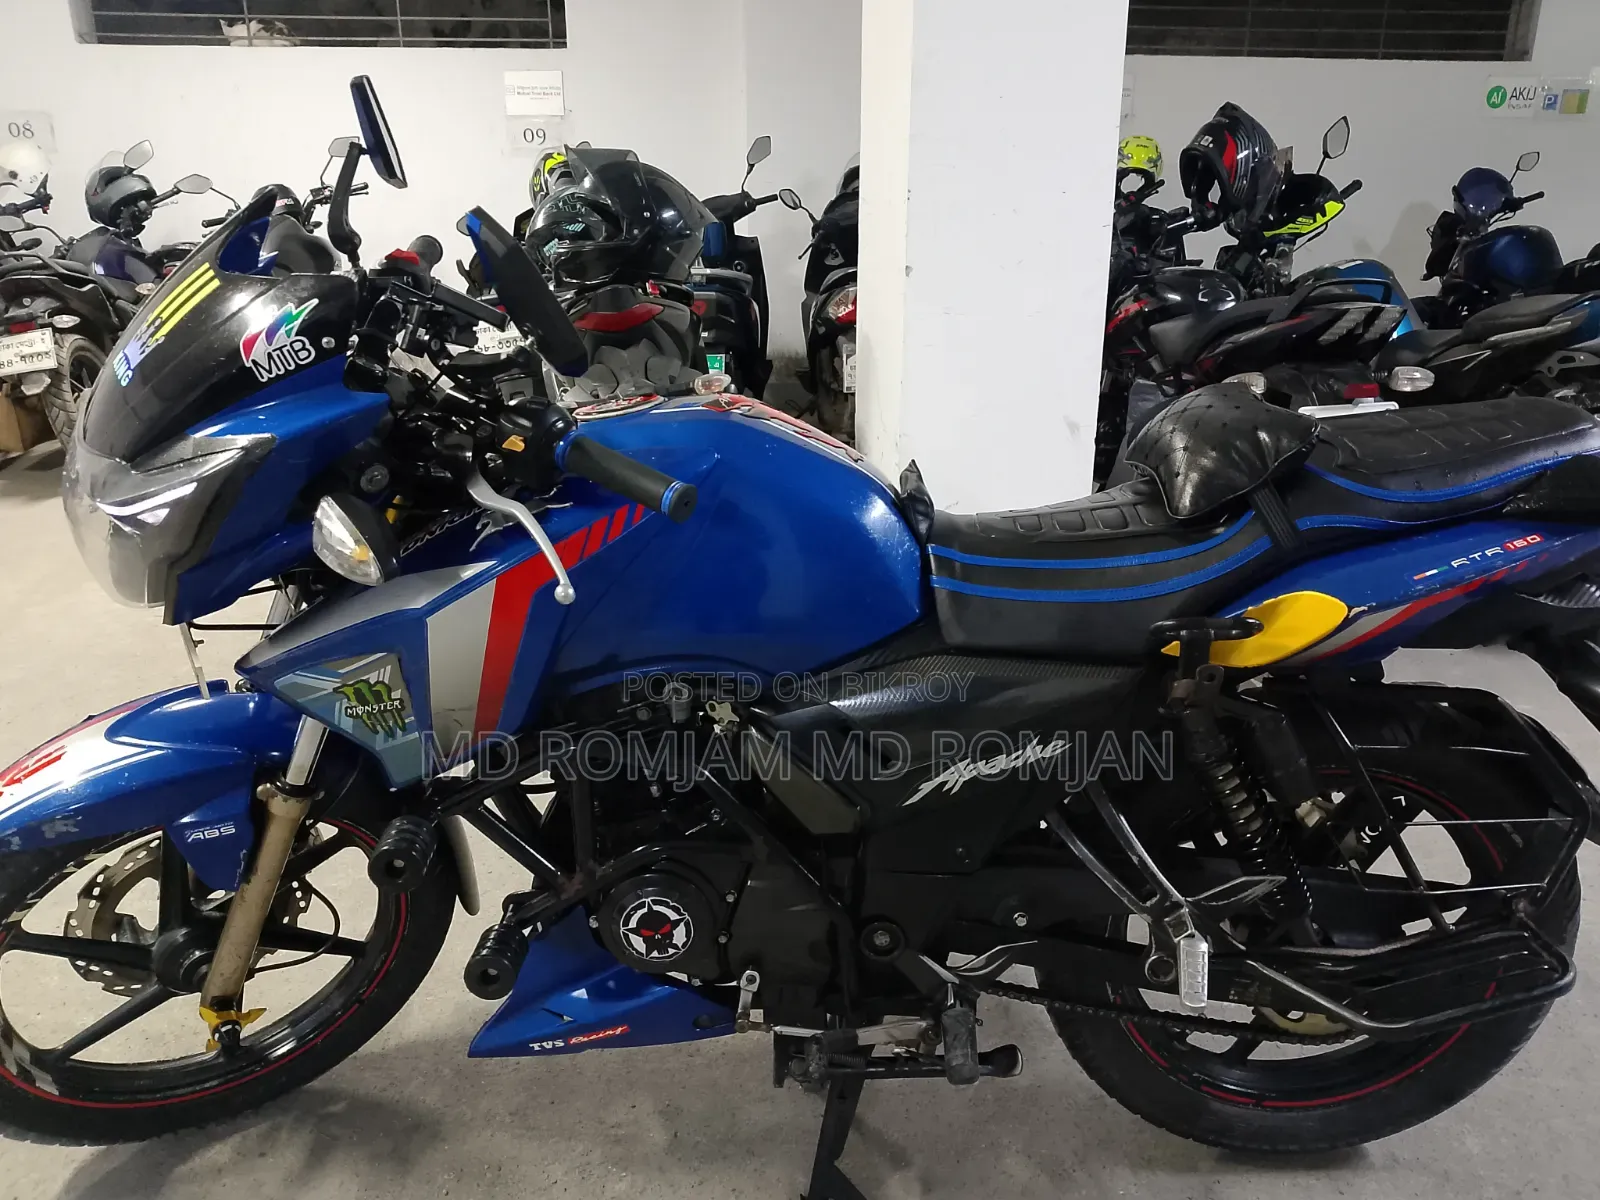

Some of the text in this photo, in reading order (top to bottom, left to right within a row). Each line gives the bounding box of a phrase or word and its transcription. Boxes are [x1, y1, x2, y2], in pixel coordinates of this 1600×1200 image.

[8, 122, 34, 139] 08
[523, 127, 546, 146] 09
[250, 337, 313, 382] MTB
[1450, 533, 1541, 568] RTR 160
[347, 700, 402, 716] MONSTER
[902, 735, 1072, 807] Apache
[187, 825, 236, 843] ABS
[528, 1025, 628, 1051] TVS Racing
